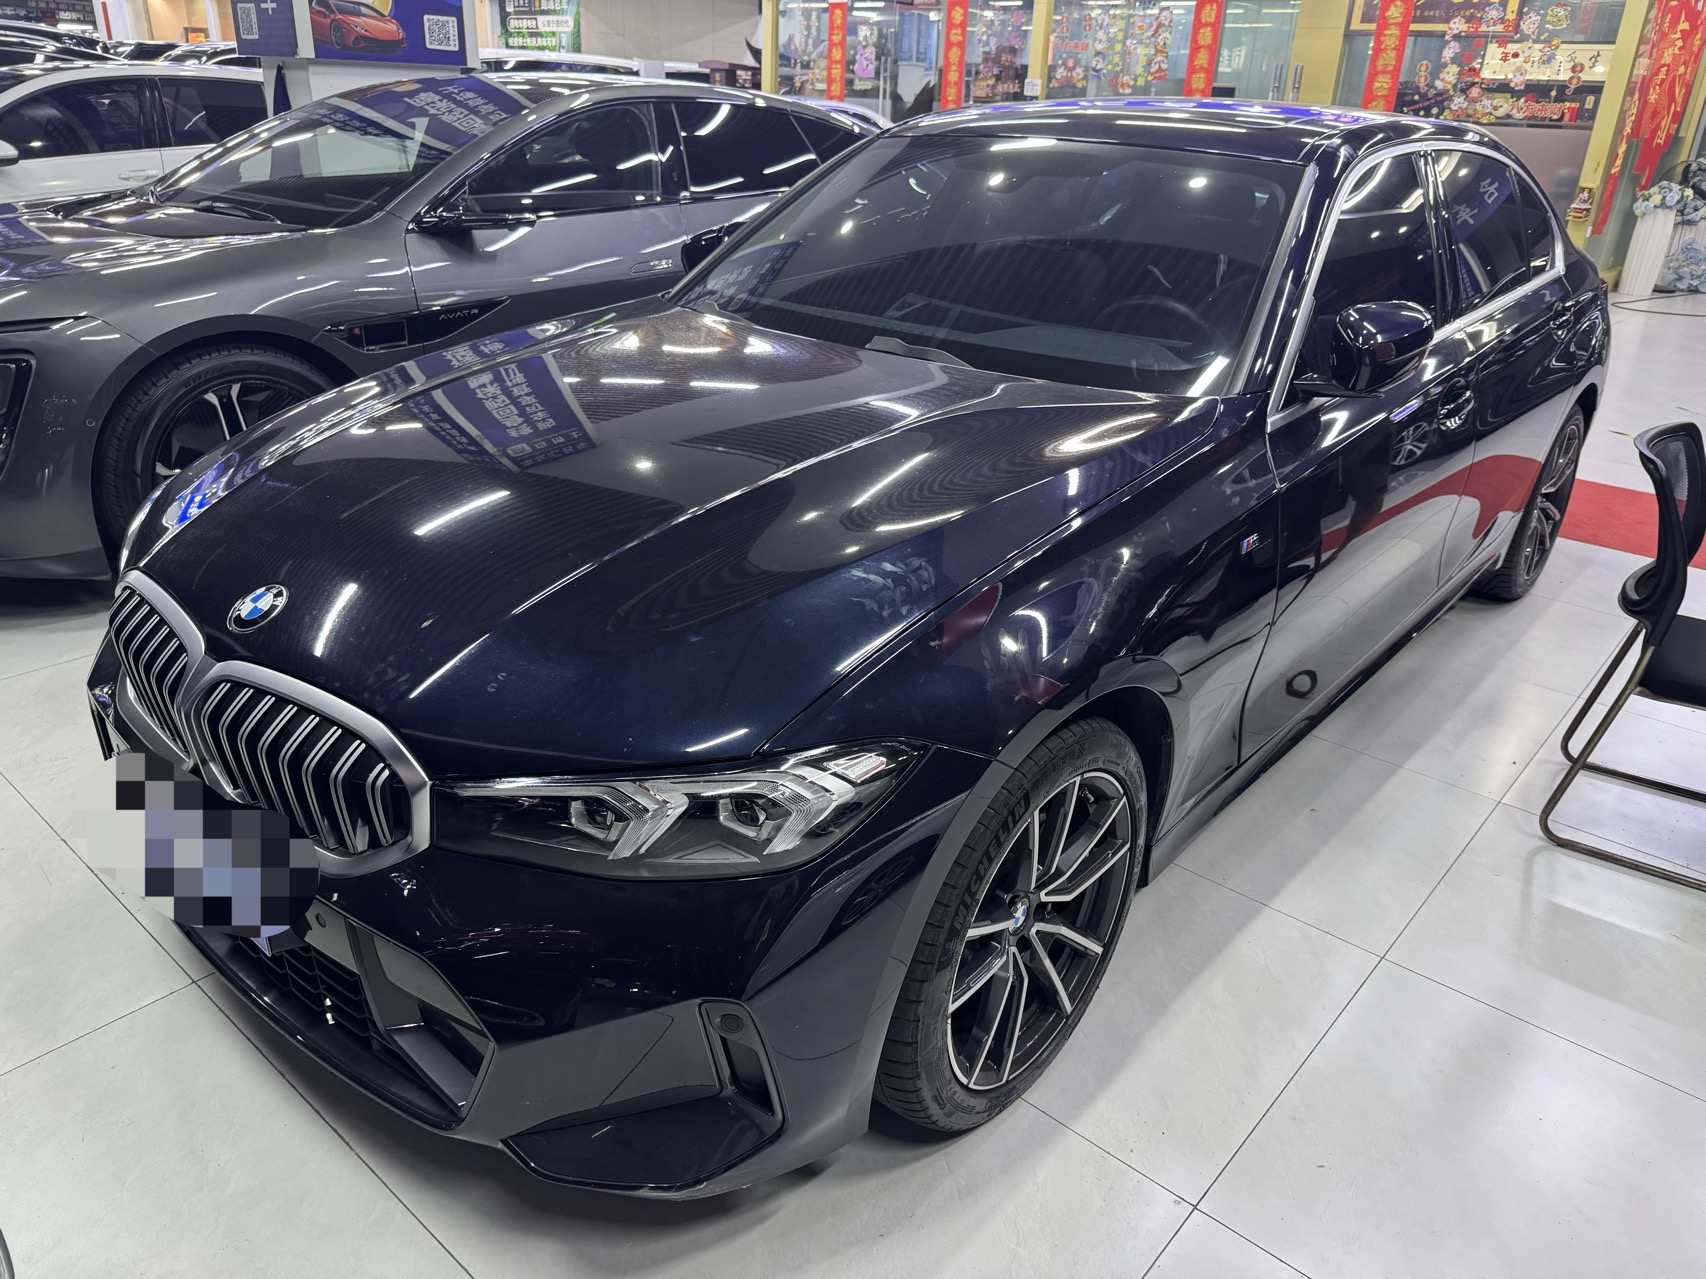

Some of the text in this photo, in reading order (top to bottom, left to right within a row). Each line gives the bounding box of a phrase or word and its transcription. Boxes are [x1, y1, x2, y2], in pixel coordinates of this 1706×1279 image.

[1509, 102, 1565, 117] 八方来财
[439, 309, 479, 321] AVATR
[952, 798, 1027, 933] MICHELIN
